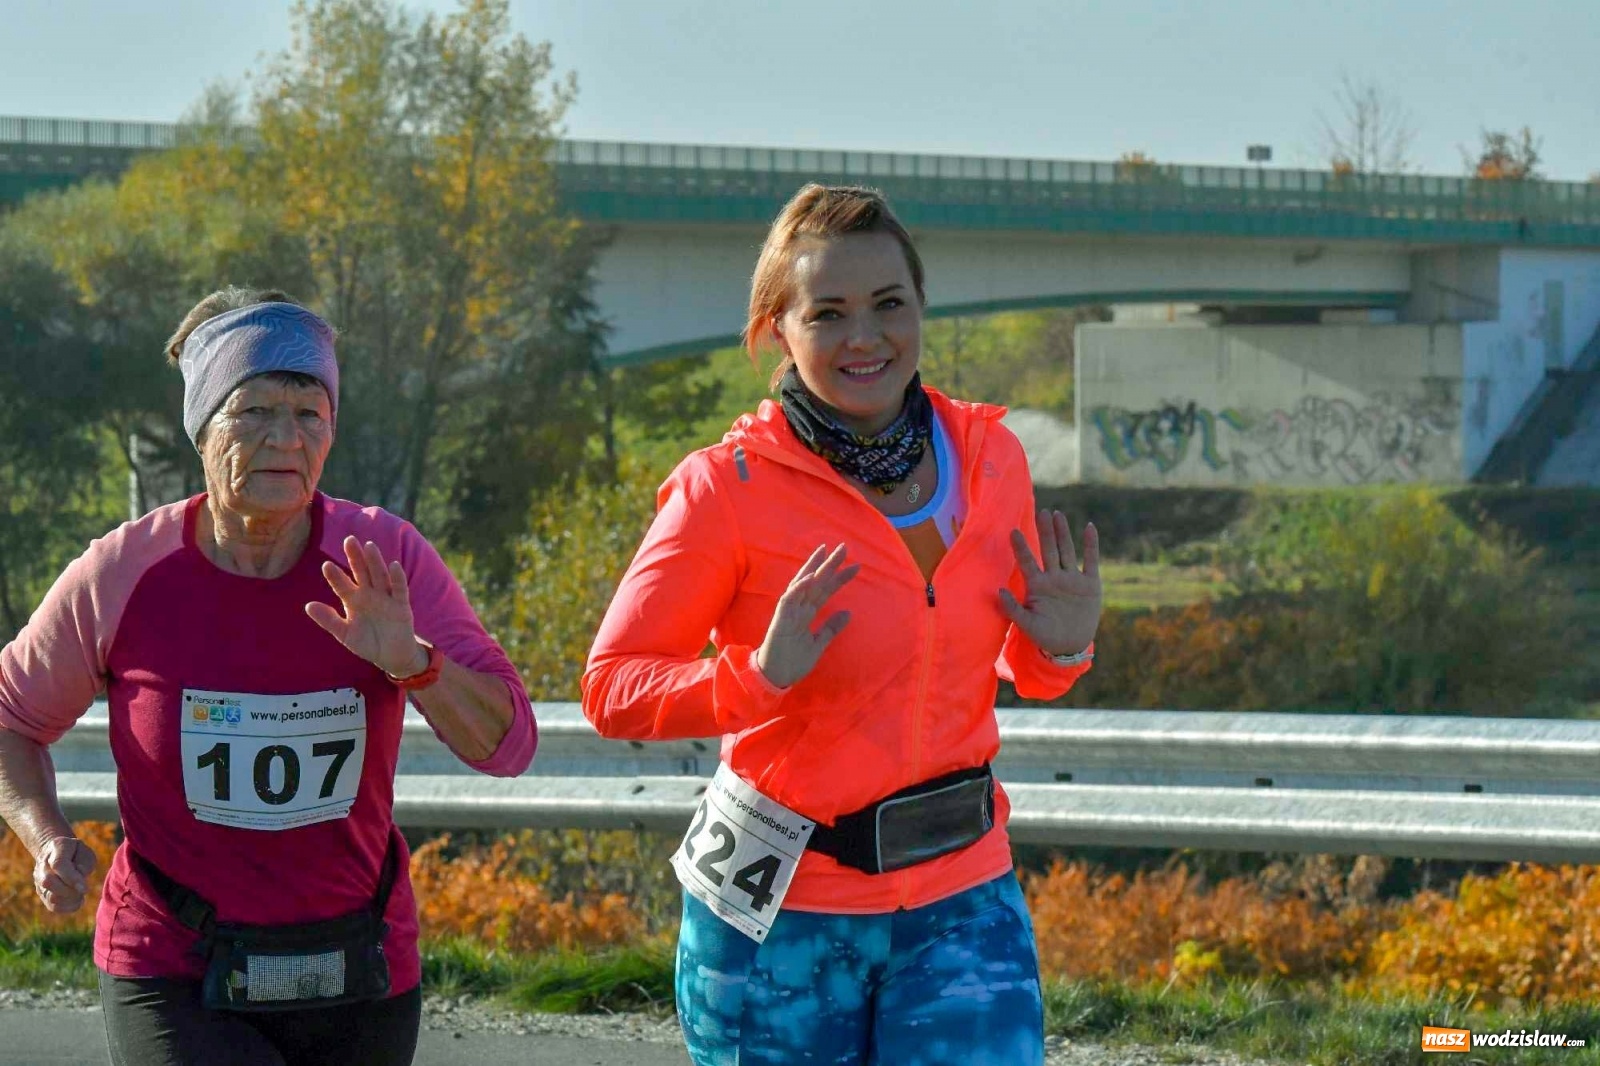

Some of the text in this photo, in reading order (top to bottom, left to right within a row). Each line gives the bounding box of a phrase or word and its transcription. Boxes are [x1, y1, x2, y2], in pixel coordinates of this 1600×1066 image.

[250, 702, 359, 723] www.personalbest.pl
[197, 738, 356, 805] 107
[723, 787, 800, 842] www.personalbest.pl
[685, 799, 782, 912] 224
